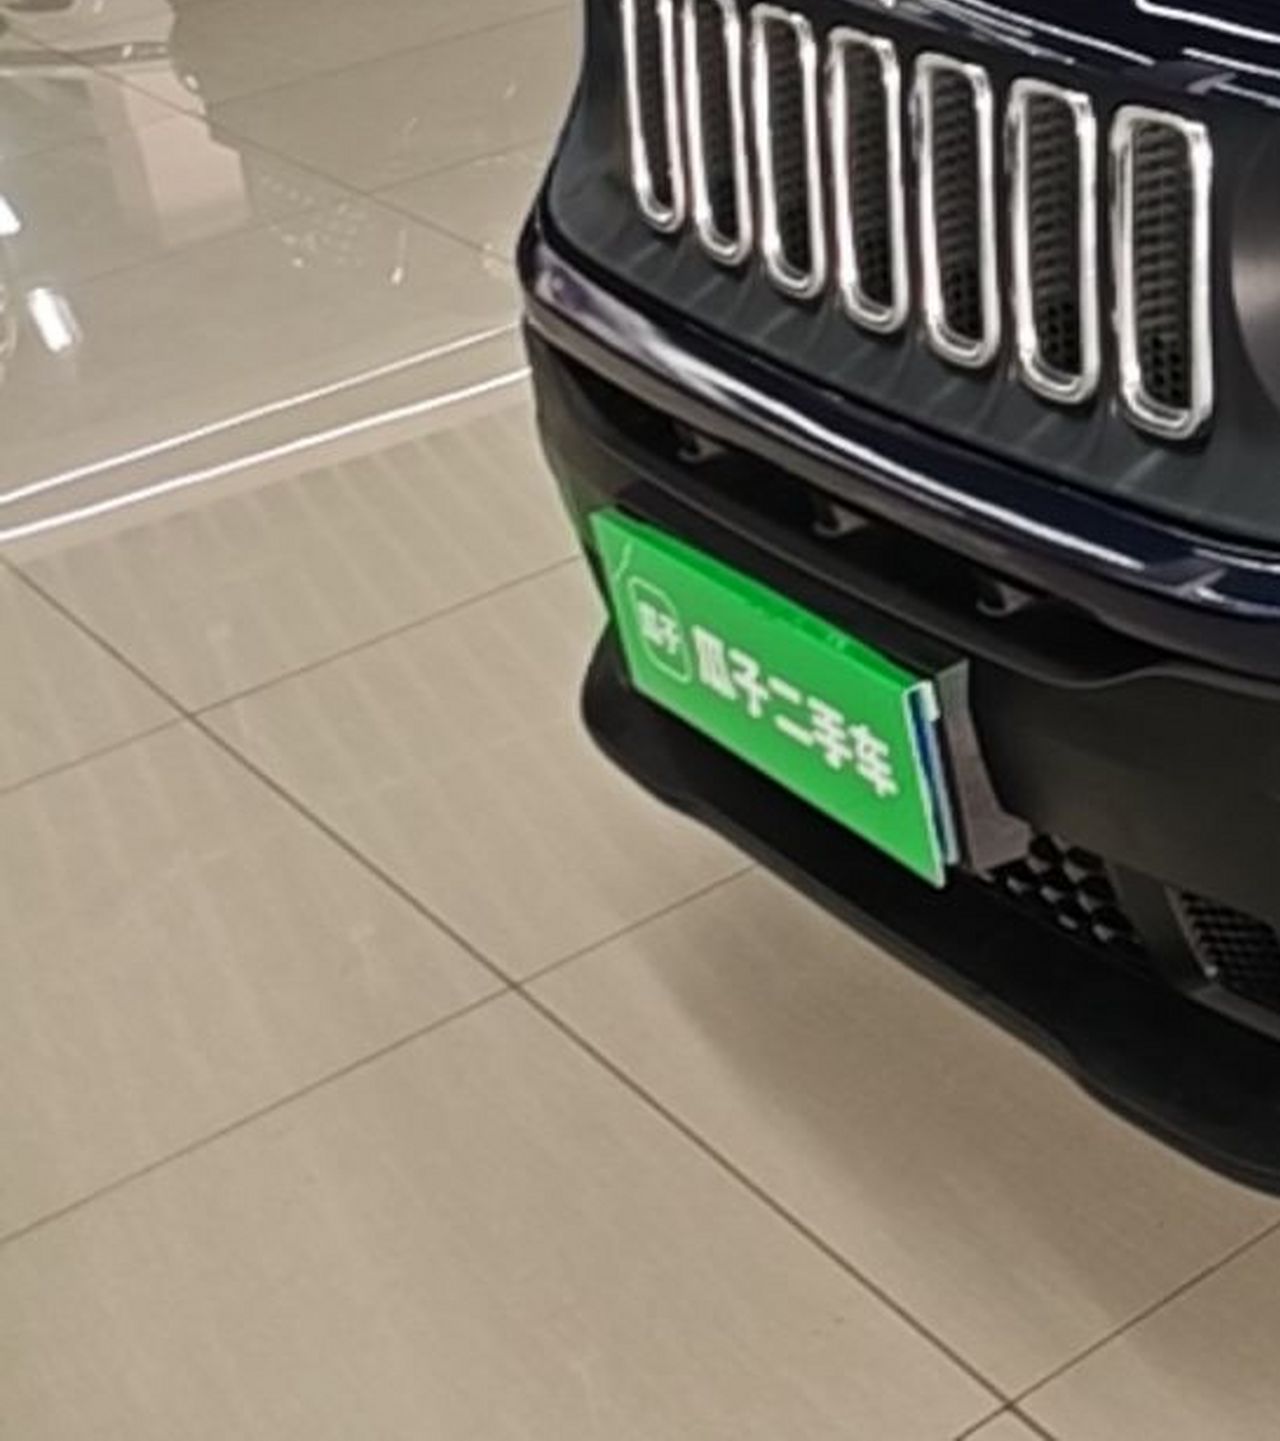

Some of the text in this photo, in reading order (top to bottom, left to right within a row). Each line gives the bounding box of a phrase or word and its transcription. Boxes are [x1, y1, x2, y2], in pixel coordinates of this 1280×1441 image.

[691, 624, 898, 797] 瓜子二手车
